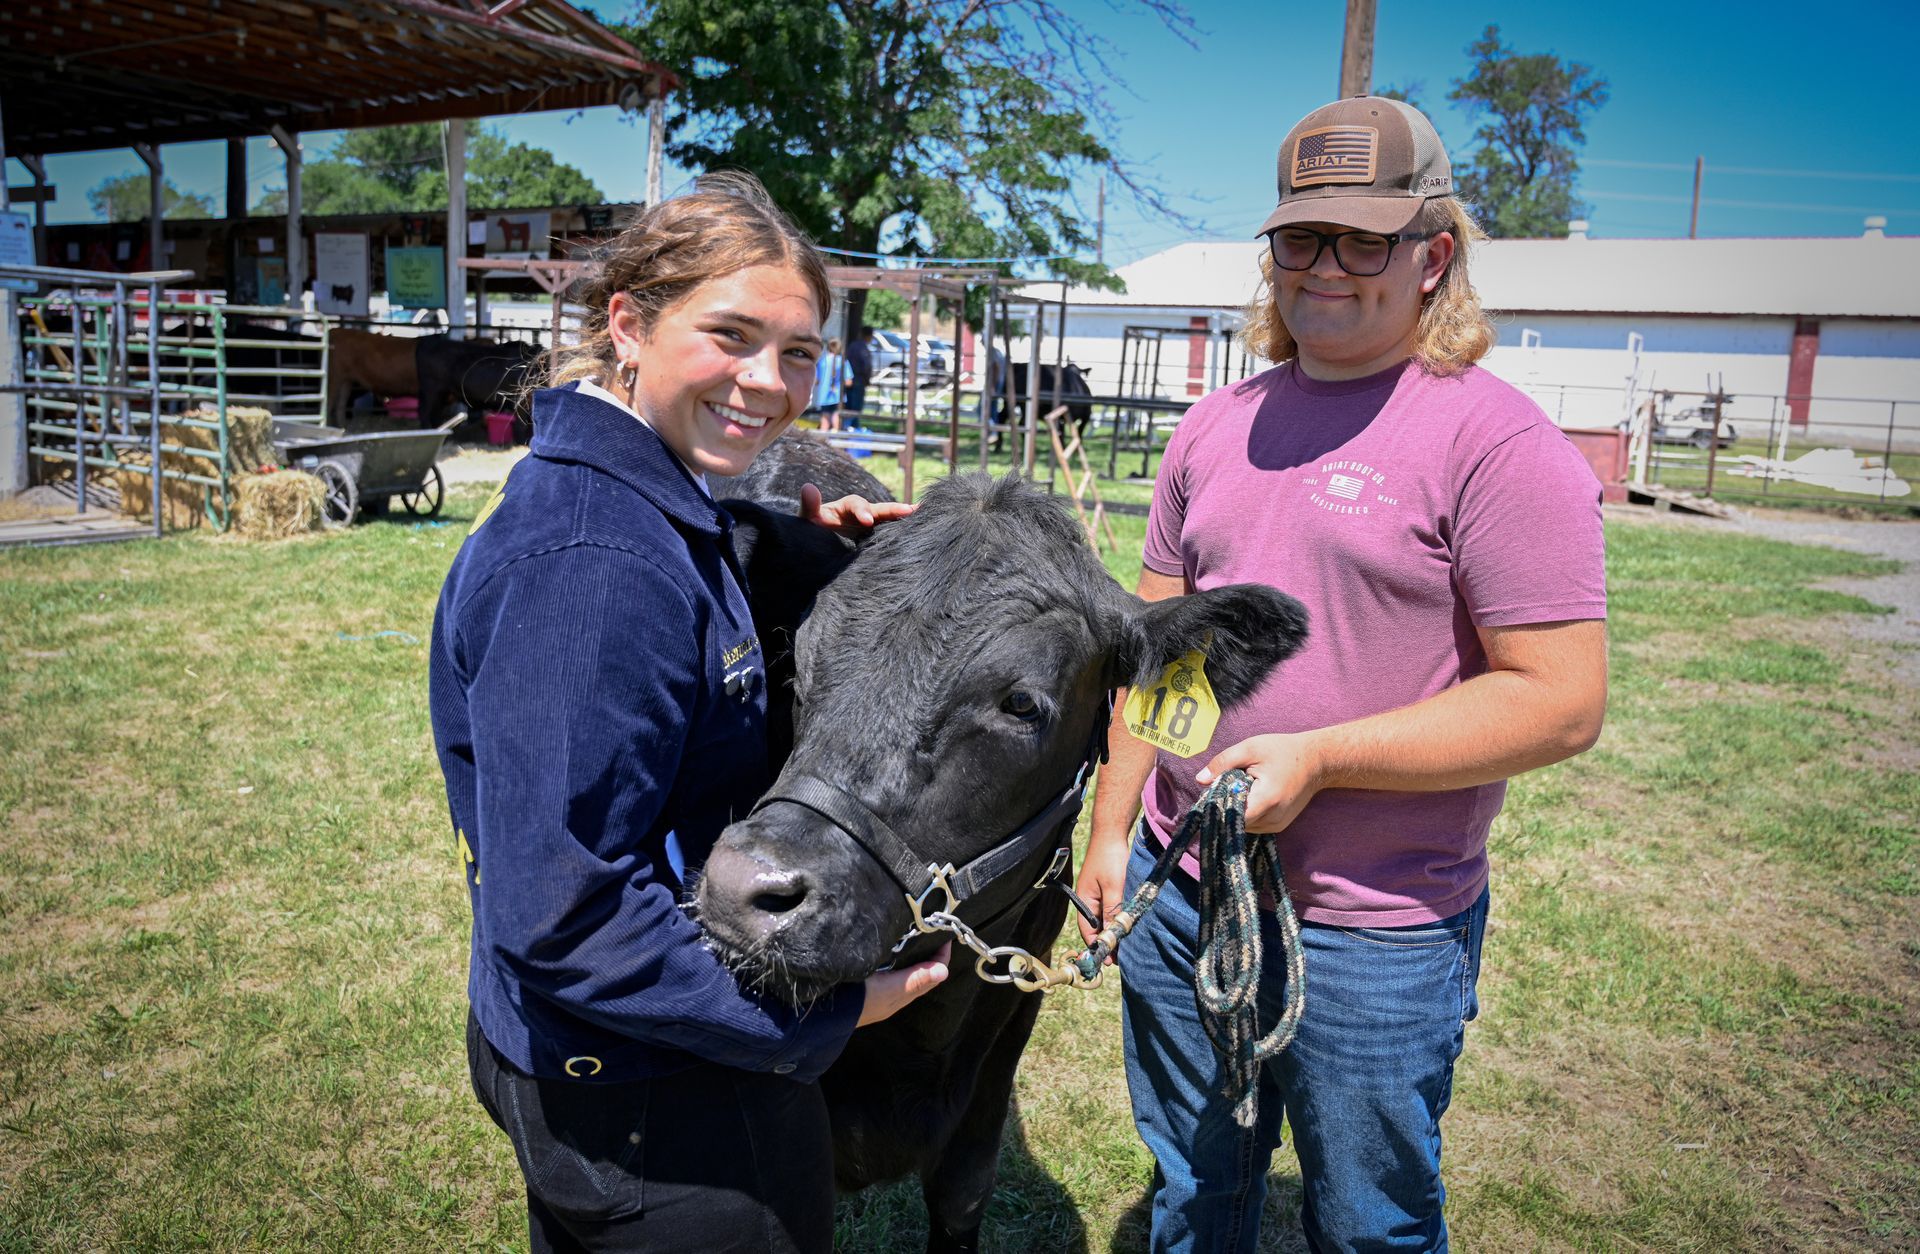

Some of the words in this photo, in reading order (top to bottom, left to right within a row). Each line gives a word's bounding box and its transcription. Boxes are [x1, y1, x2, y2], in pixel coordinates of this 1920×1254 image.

[1297, 155, 1346, 170] ARIAT
[1322, 461, 1349, 473] ARIAT
[1350, 461, 1374, 477] BOOT
[1310, 493, 1369, 514] REGISTERED
[1142, 686, 1198, 740] 18
[1160, 735, 1178, 749] HOME
[1177, 742, 1191, 755] FFA
